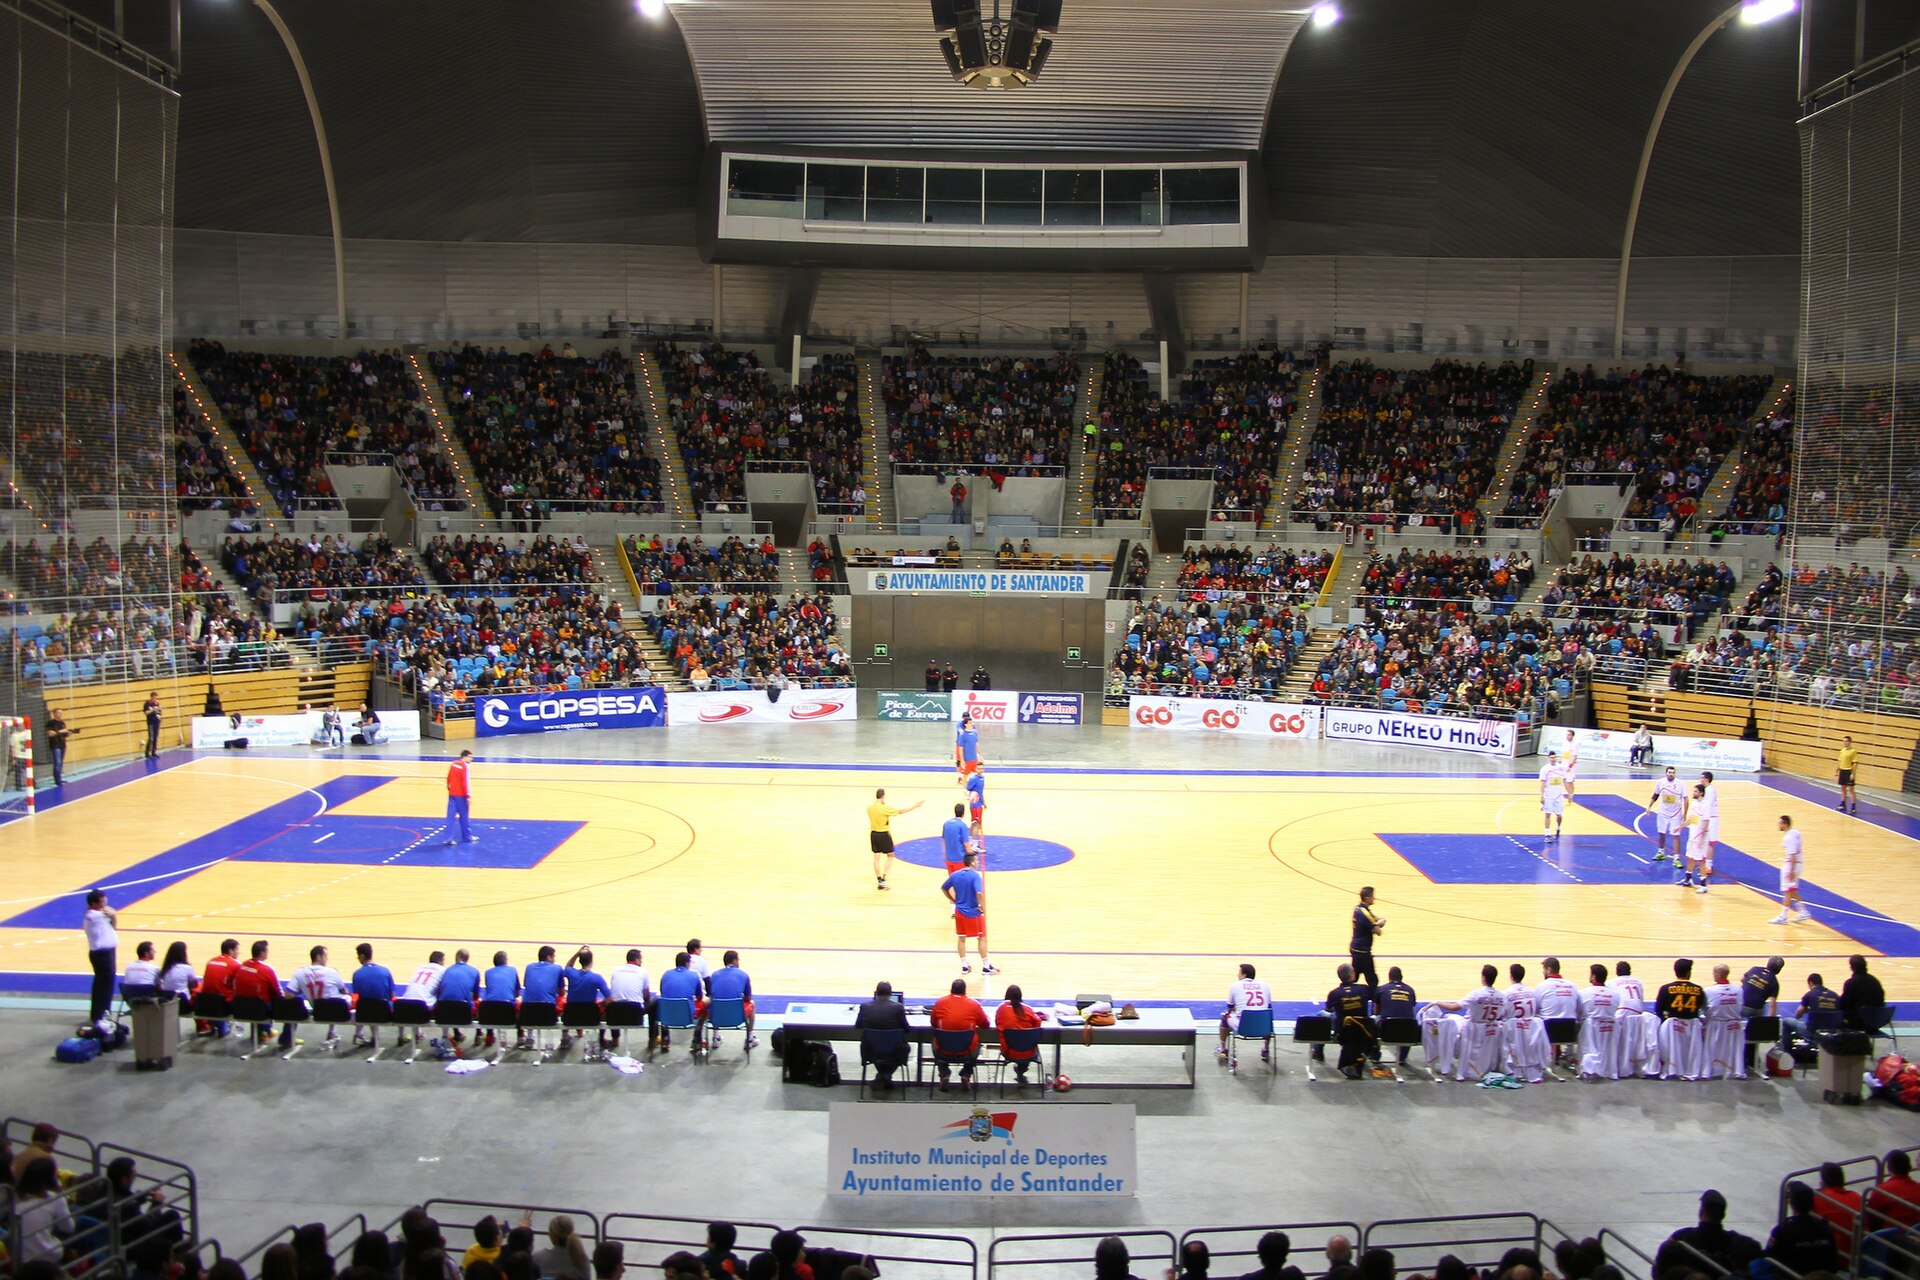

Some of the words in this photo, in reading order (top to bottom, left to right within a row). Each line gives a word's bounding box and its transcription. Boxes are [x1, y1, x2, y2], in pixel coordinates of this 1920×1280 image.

[890, 573, 986, 590] AYUNTAMIENTO
[991, 574, 1007, 591] DE
[1010, 575, 1084, 592] SANTANDER
[520, 695, 658, 721] COPSESA
[885, 700, 914, 709] Picos
[1035, 702, 1078, 714] Adelma
[1136, 705, 1173, 725] GO
[1168, 700, 1181, 711] fit
[888, 710, 903, 718] de
[906, 709, 949, 720] Europa
[1202, 709, 1240, 729] GO
[1235, 704, 1248, 715] fit
[1269, 713, 1305, 733] GO
[1301, 708, 1314, 719] fit
[1332, 722, 1373, 735] GRUPO
[1377, 718, 1443, 741] NEREO
[1245, 991, 1264, 1007] 25
[1624, 985, 1641, 999] 11
[1513, 1000, 1534, 1019] 51
[1671, 995, 1697, 1012] 44
[1482, 1006, 1498, 1021] 15
[852, 1147, 921, 1166] Instituto
[928, 1147, 1006, 1169] Municipal
[1010, 1149, 1030, 1166] de
[1035, 1148, 1107, 1169] Deportes
[842, 1170, 983, 1196] Ayuntamiento
[990, 1172, 1015, 1192] de
[1021, 1170, 1124, 1193] Santander
